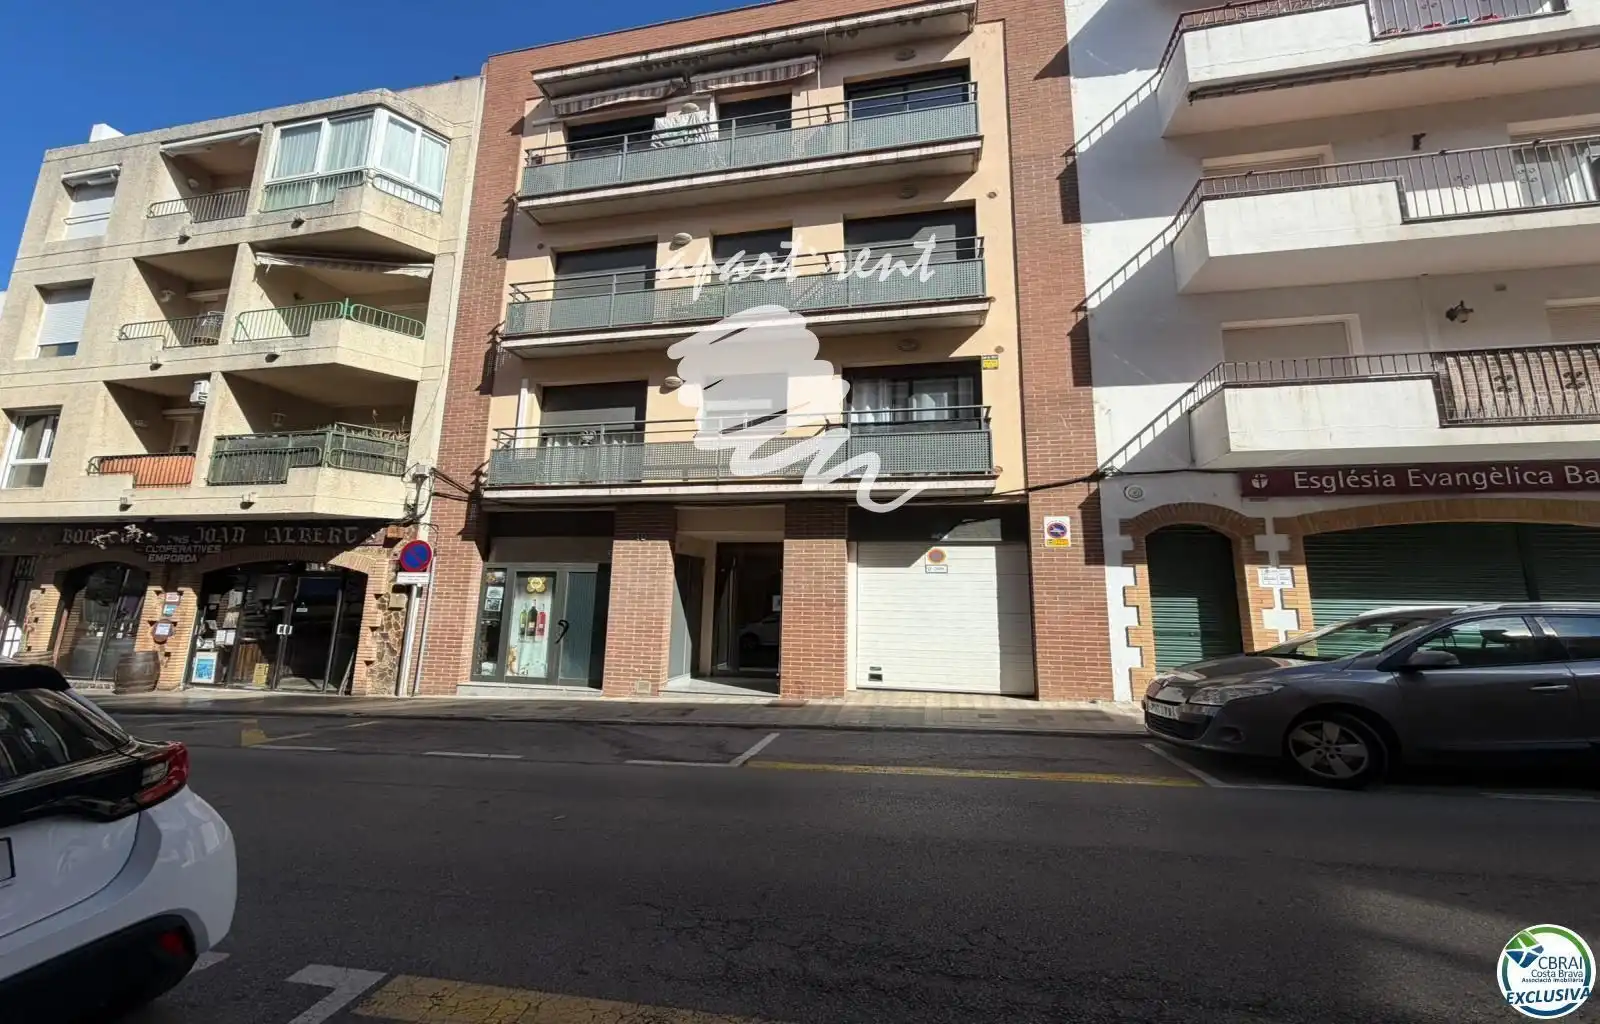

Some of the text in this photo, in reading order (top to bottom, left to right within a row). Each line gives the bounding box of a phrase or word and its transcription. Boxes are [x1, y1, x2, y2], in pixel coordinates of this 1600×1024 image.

[1294, 468, 1396, 494] Església
[1407, 465, 1554, 491] Evangèlica
[193, 526, 247, 544] JOAN
[263, 526, 359, 544] ALBERT
